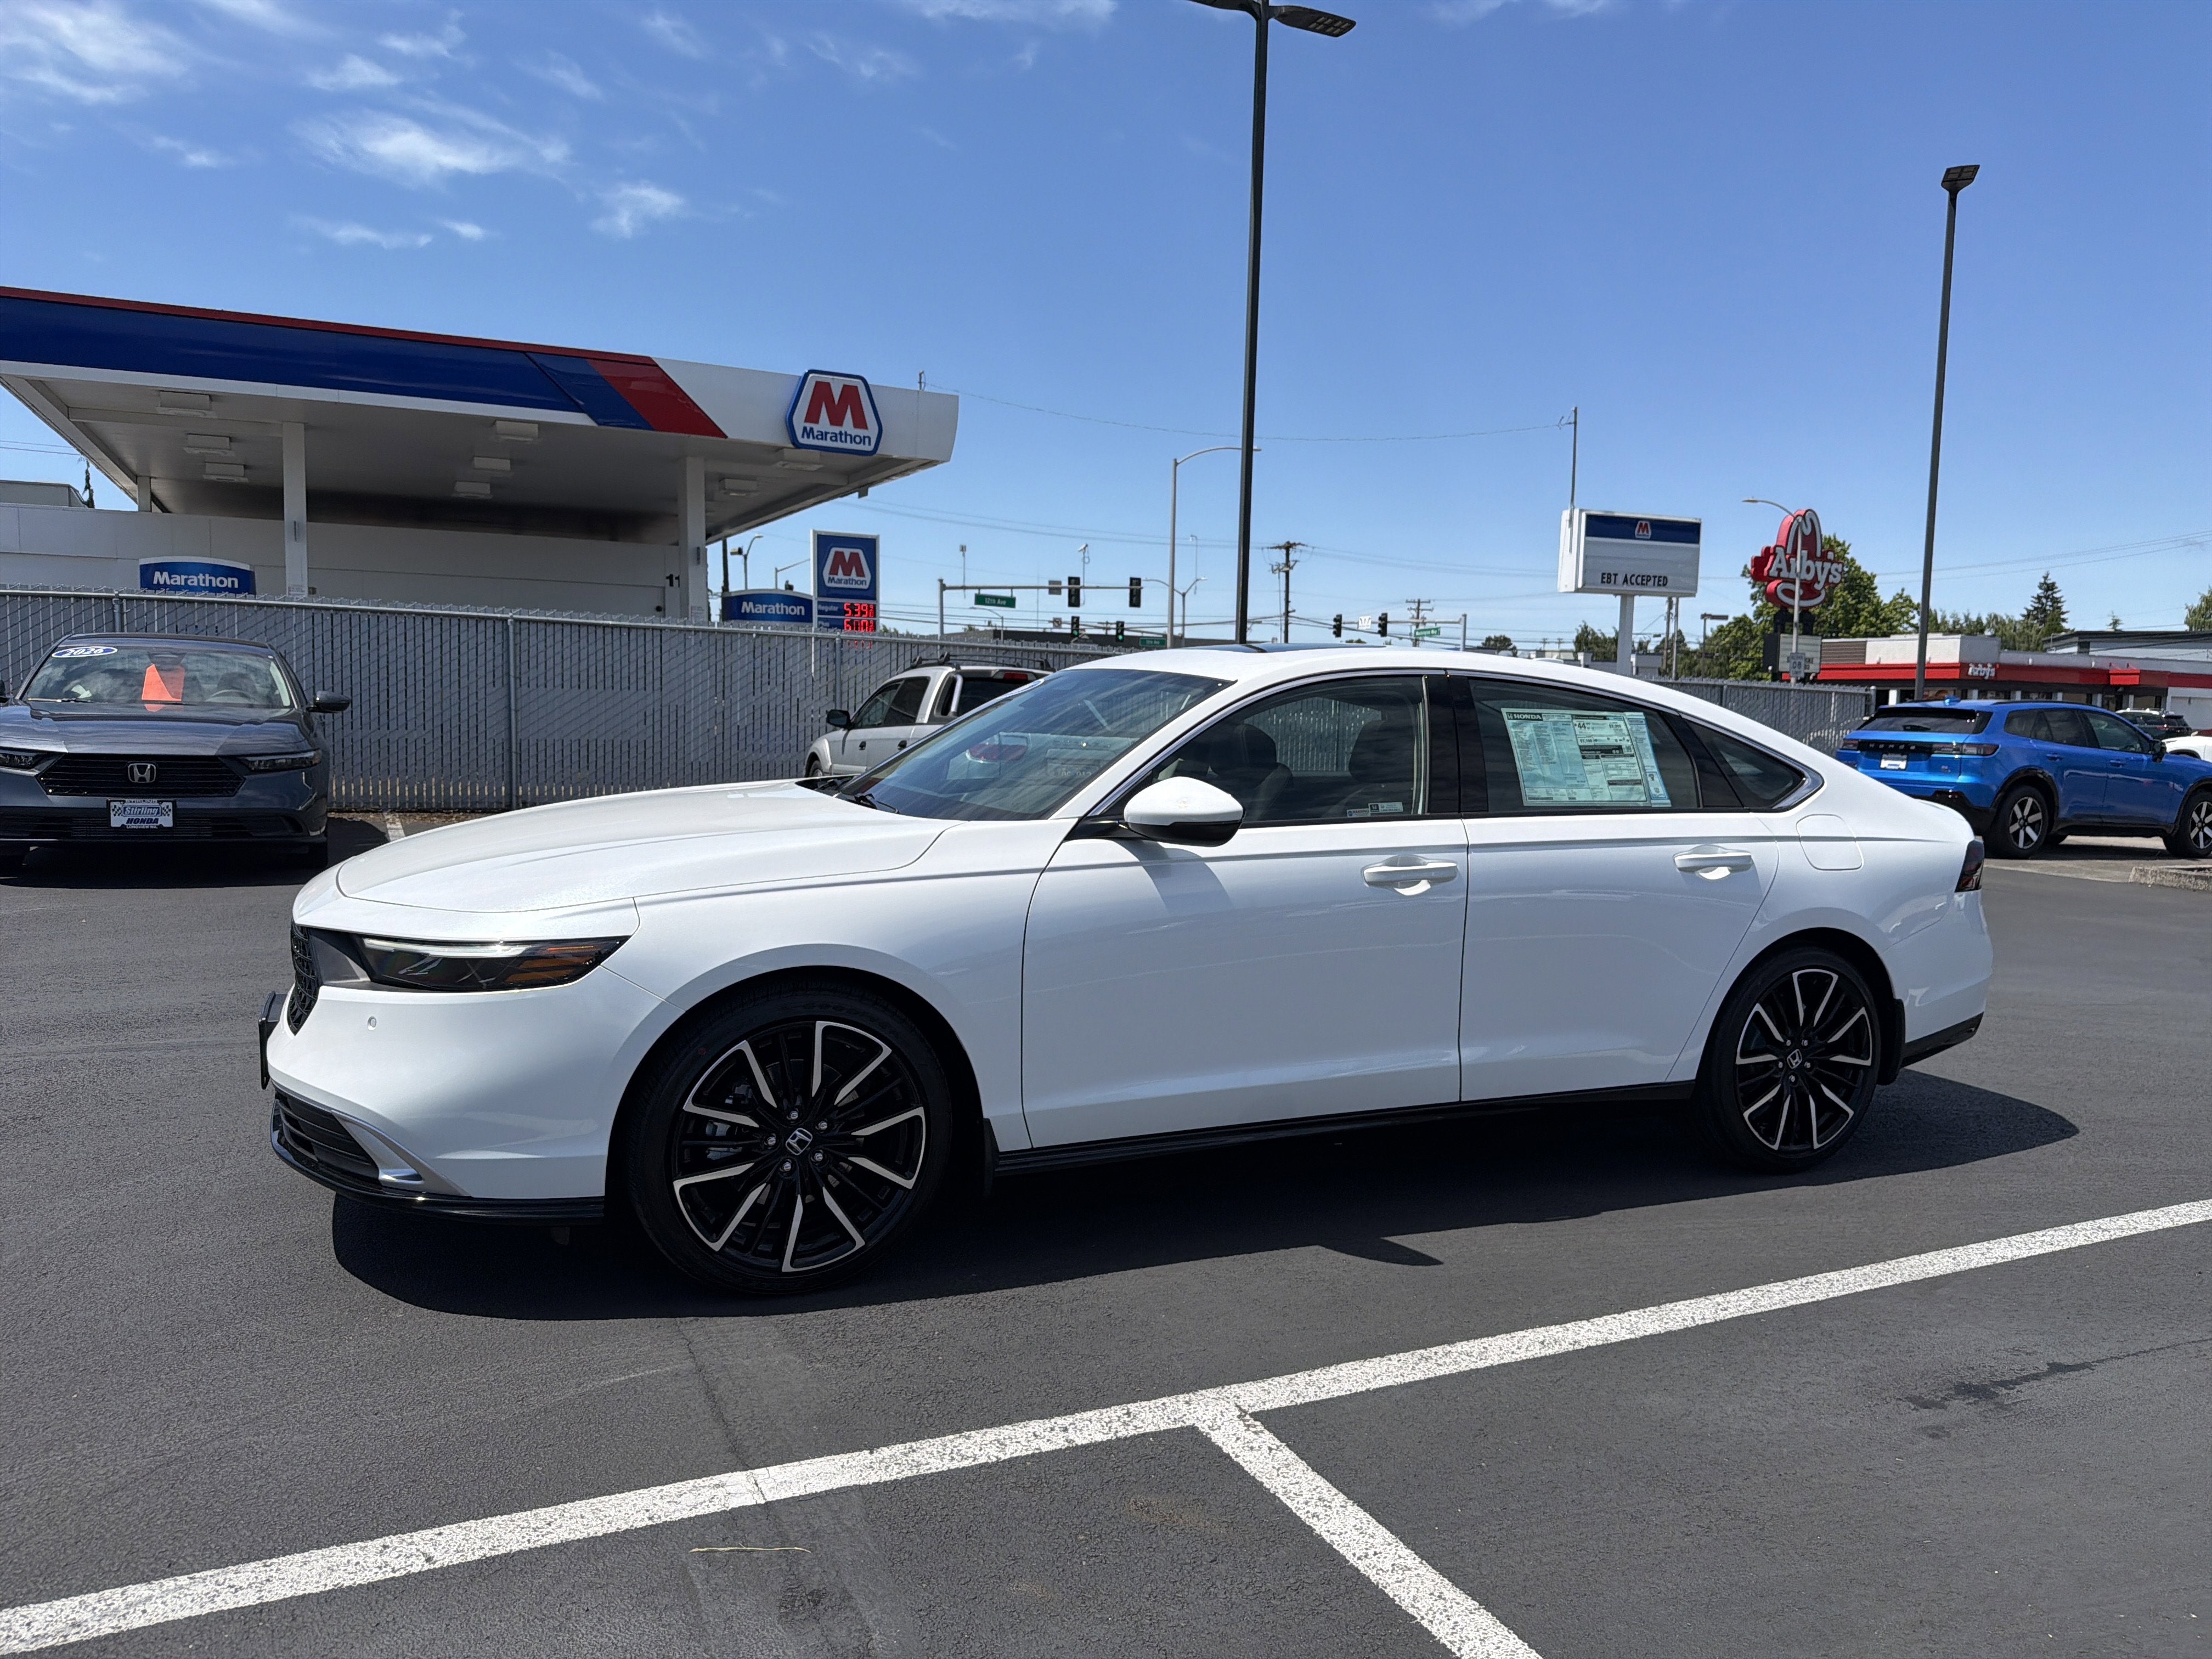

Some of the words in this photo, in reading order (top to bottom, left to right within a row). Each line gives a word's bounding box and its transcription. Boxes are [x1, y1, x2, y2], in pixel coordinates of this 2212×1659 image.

[802, 426, 871, 446] Marathon
[153, 571, 239, 588] Marathon
[827, 576, 867, 586] Marathon
[1601, 572, 1618, 584] EBT
[1622, 573, 1668, 587] ACCEPTED
[741, 601, 805, 616] Marathon
[61, 648, 104, 657] 2026
[125, 806, 159, 816] Stirling
